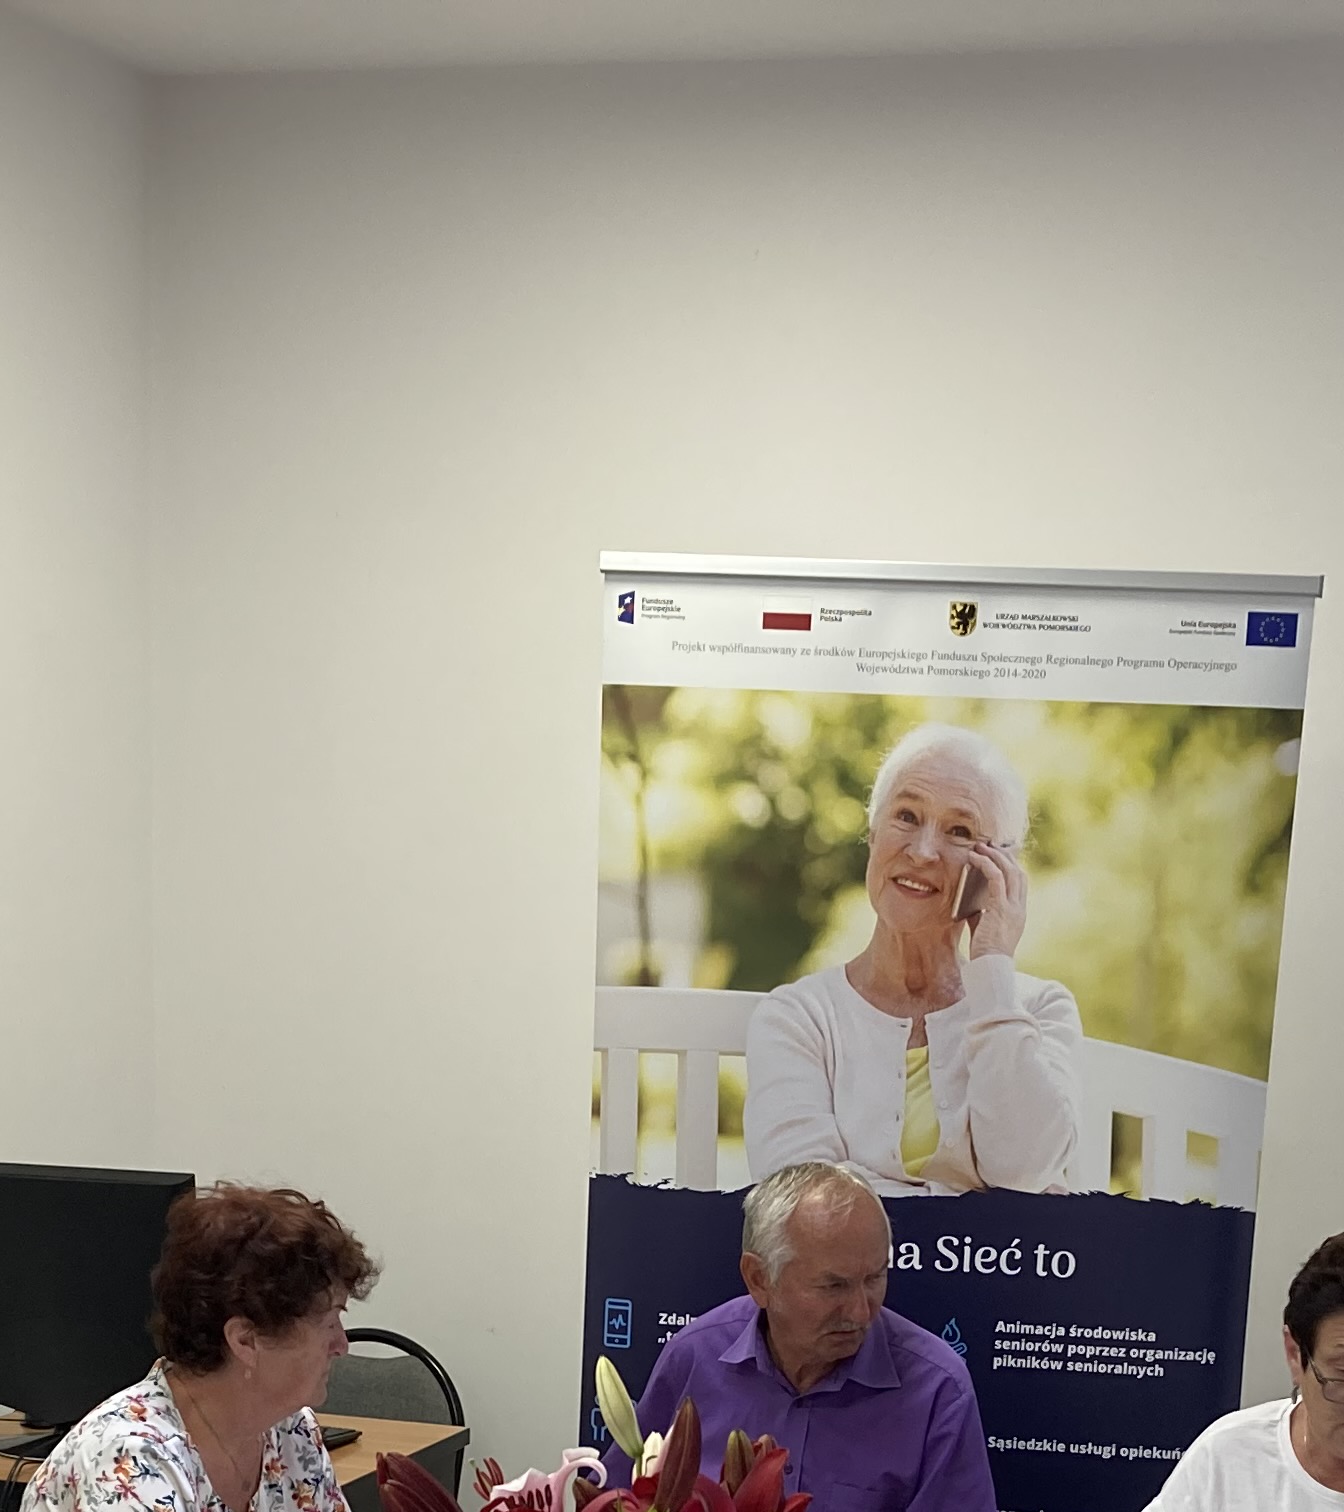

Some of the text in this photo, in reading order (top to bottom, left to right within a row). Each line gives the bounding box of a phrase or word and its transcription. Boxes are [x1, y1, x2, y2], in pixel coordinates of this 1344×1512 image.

[819, 615, 843, 623] Polska
[671, 640, 707, 653] Projekt
[709, 642, 797, 657] współfinansowany
[800, 648, 812, 656] ze
[814, 644, 856, 658] środków
[858, 647, 928, 662] Europejskiego
[931, 649, 978, 663] Funduszu
[1045, 653, 1114, 669] Regionalnego
[1116, 656, 1165, 670] Programu
[1167, 659, 1238, 673] Operacyjnego
[856, 662, 1047, 680] Województwa Pomorskiego 2014-2020
[934, 1235, 1023, 1276] Sieć
[1034, 1243, 1077, 1279] to
[994, 1320, 1157, 1342] Animacja środowiska
[994, 1338, 1217, 1365] seniorów poprzez organizację
[992, 1354, 1165, 1379] pikników senioralnych
[987, 1435, 1066, 1453] Sąsiedzkie
[1069, 1441, 1117, 1460] usługi
